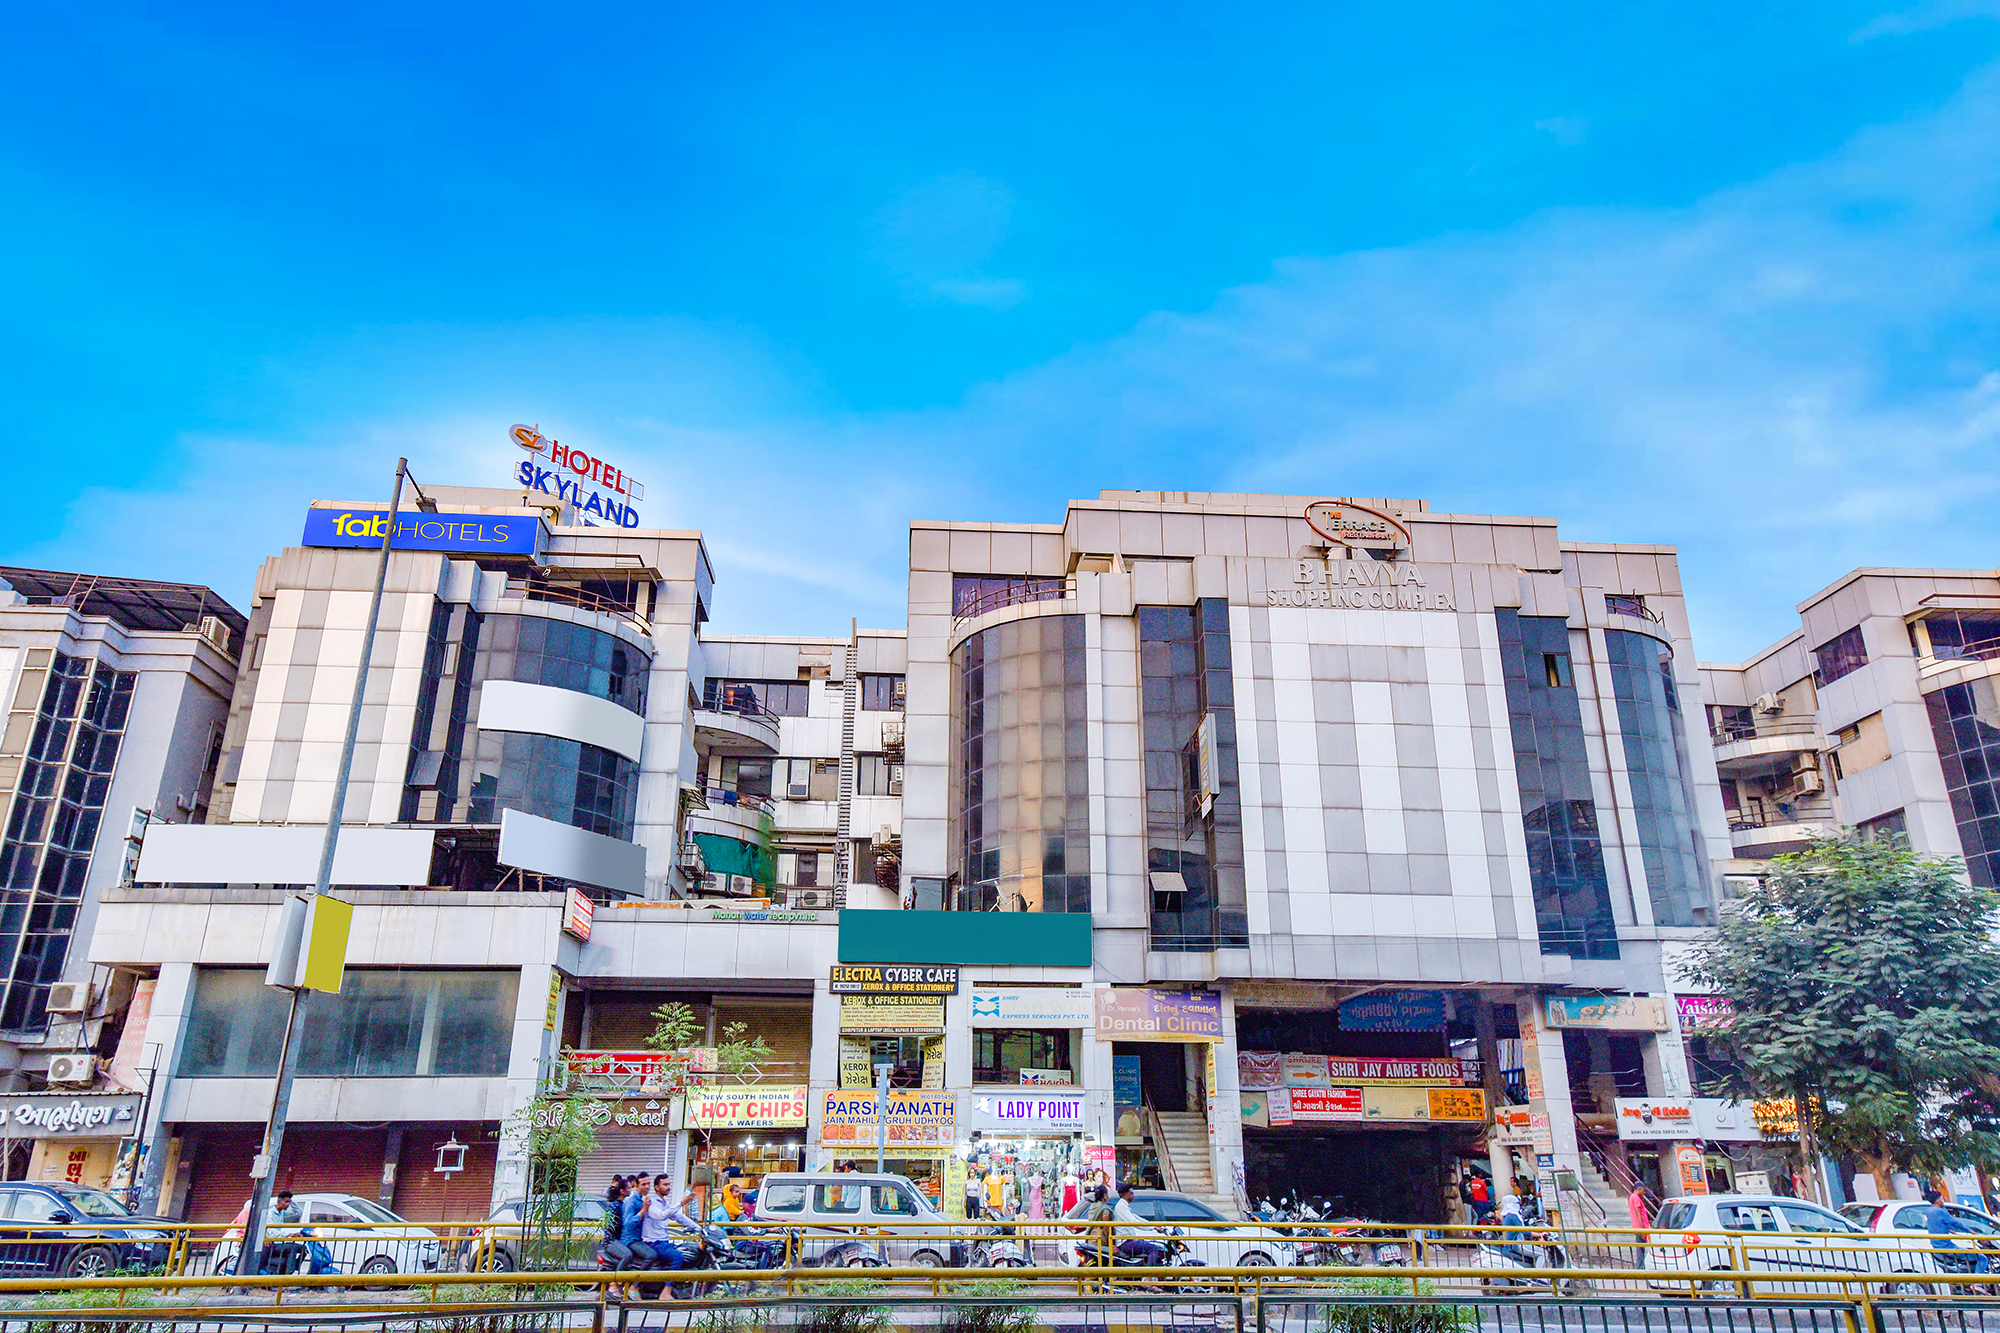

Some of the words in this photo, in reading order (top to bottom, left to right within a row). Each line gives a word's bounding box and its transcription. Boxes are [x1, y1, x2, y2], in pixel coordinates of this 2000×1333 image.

[551, 439, 626, 495] HOTEL
[518, 460, 640, 529] SKYLAND
[1293, 560, 1426, 587] BHAVYA
[1267, 588, 1365, 609] SHOPPING
[1368, 590, 1457, 611] COMPLEX
[712, 910, 742, 920] Manan
[743, 911, 768, 921] water
[832, 967, 882, 982] ELECTRA
[885, 968, 923, 982] CYBER
[926, 968, 956, 983] CAFE
[862, 983, 884, 991] XEROX
[885, 983, 890, 991] &
[892, 983, 915, 991] OFFICE
[916, 983, 955, 992] STATIONERY
[843, 996, 867, 1005] XEROX
[868, 996, 873, 1005] &
[874, 996, 899, 1005] OFFICE
[900, 996, 942, 1005] STATIONERY
[1100, 1015, 1160, 1031] Dental
[1167, 1016, 1218, 1032] Clinic
[843, 1063, 868, 1071] XEROX
[1332, 1062, 1359, 1077] SHRI
[1362, 1063, 1382, 1077] JAY
[1386, 1063, 1418, 1078] AMBE
[1421, 1063, 1460, 1078] FOODS
[1292, 1089, 1308, 1098] SHREE
[15, 1100, 114, 1132] આભૂષણ
[701, 1102, 741, 1118] HOT
[746, 1101, 804, 1118] CHIPS
[998, 1101, 1033, 1119] LADY
[1038, 1101, 1080, 1119] POINT
[737, 1119, 774, 1127] WAFERS
[824, 1116, 845, 1125] JAIN
[885, 1116, 912, 1125] GRUH
[914, 1117, 954, 1125] UDHYOG
